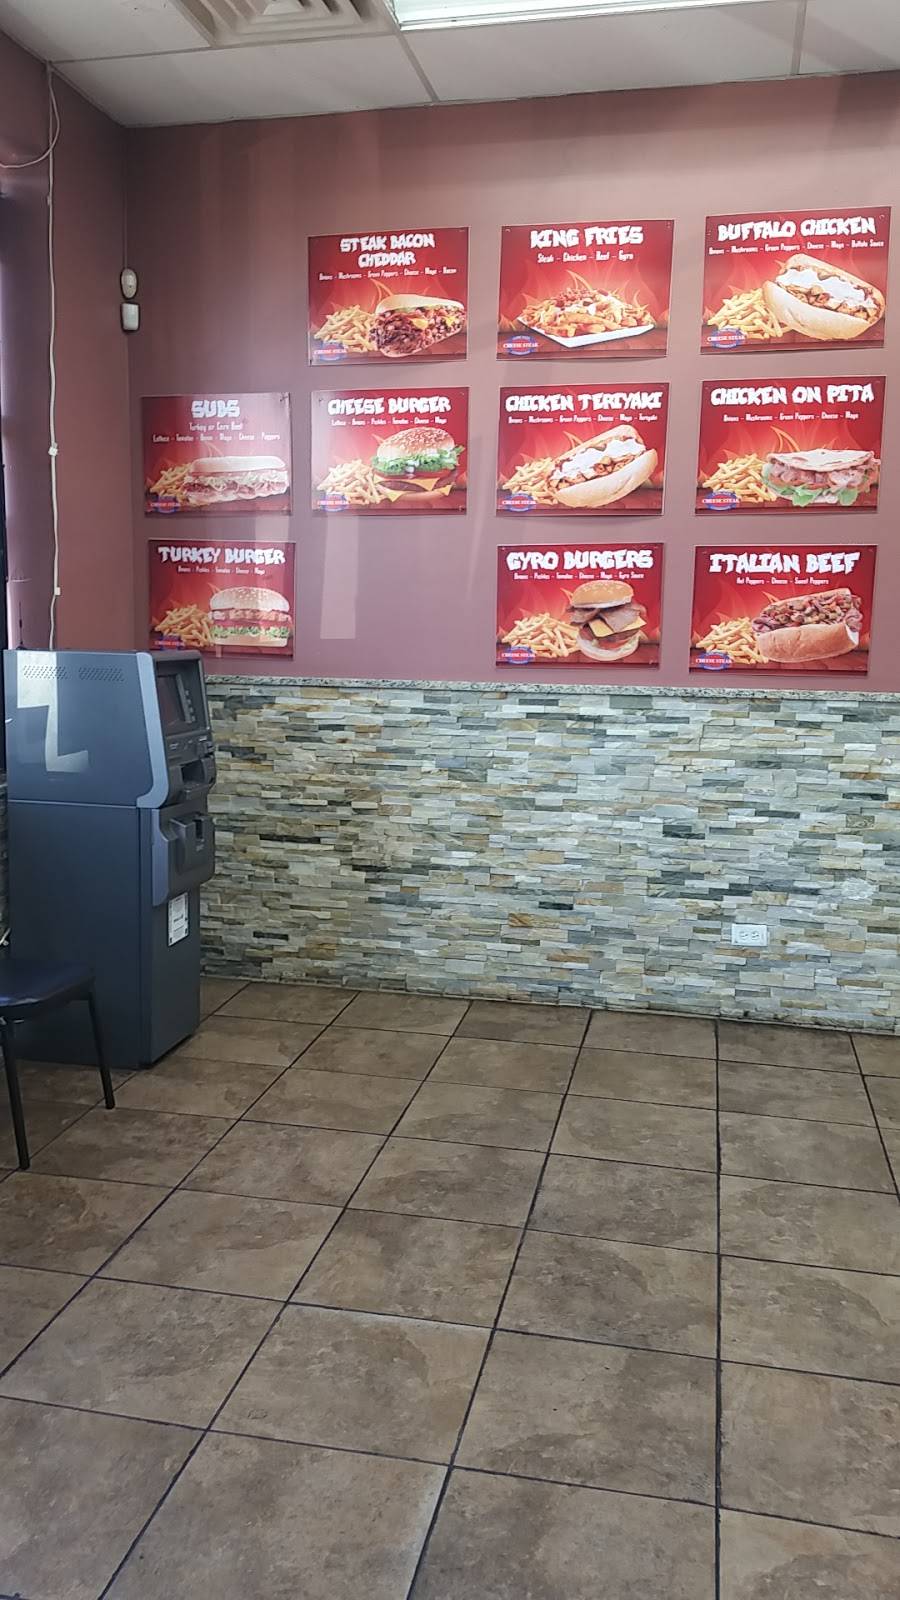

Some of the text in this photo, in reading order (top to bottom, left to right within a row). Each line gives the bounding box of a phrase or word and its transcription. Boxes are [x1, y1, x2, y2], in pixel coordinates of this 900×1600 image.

[530, 226, 643, 249] KING FRIES
[718, 216, 876, 241] BUFFALO CHICKEN
[340, 234, 435, 252] STEAK BACON
[358, 251, 416, 268] CHEDDAR
[506, 391, 663, 412] CHICKEN TERIYAKI
[711, 383, 874, 406] CHICKEN ON PITA
[191, 400, 240, 418] SUBS
[328, 396, 451, 415] CHEESE BURGER
[158, 546, 285, 565] TURKEY BURGER
[507, 549, 653, 570] GYRO BURGERS
[709, 552, 860, 574] ITALIAN BEEF
